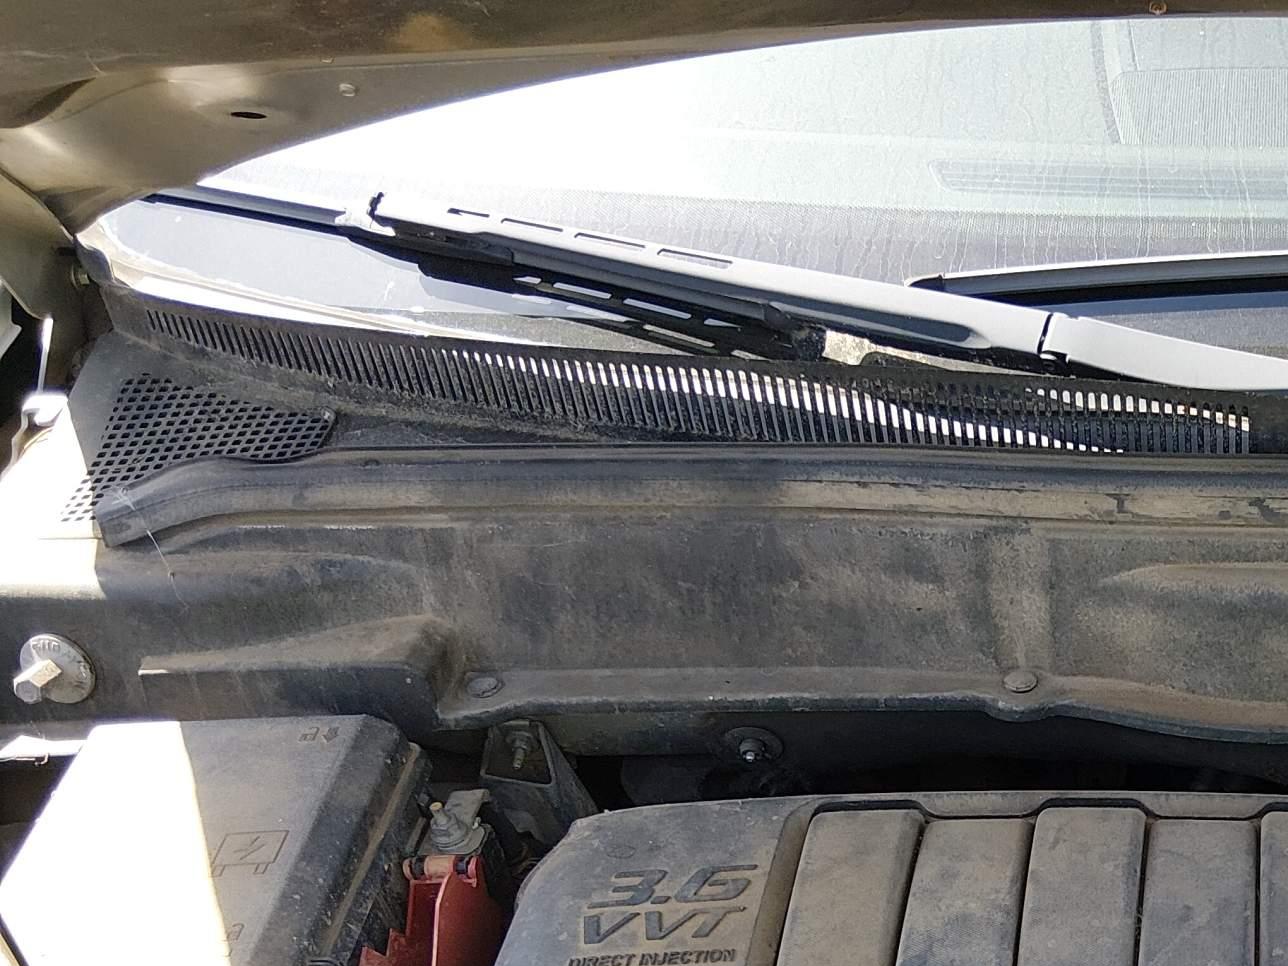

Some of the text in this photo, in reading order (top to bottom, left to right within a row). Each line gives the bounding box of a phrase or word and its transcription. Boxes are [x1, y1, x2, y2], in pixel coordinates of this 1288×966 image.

[587, 864, 759, 909] 3.6
[583, 906, 747, 944] VVT
[639, 949, 737, 966] INJECTION
